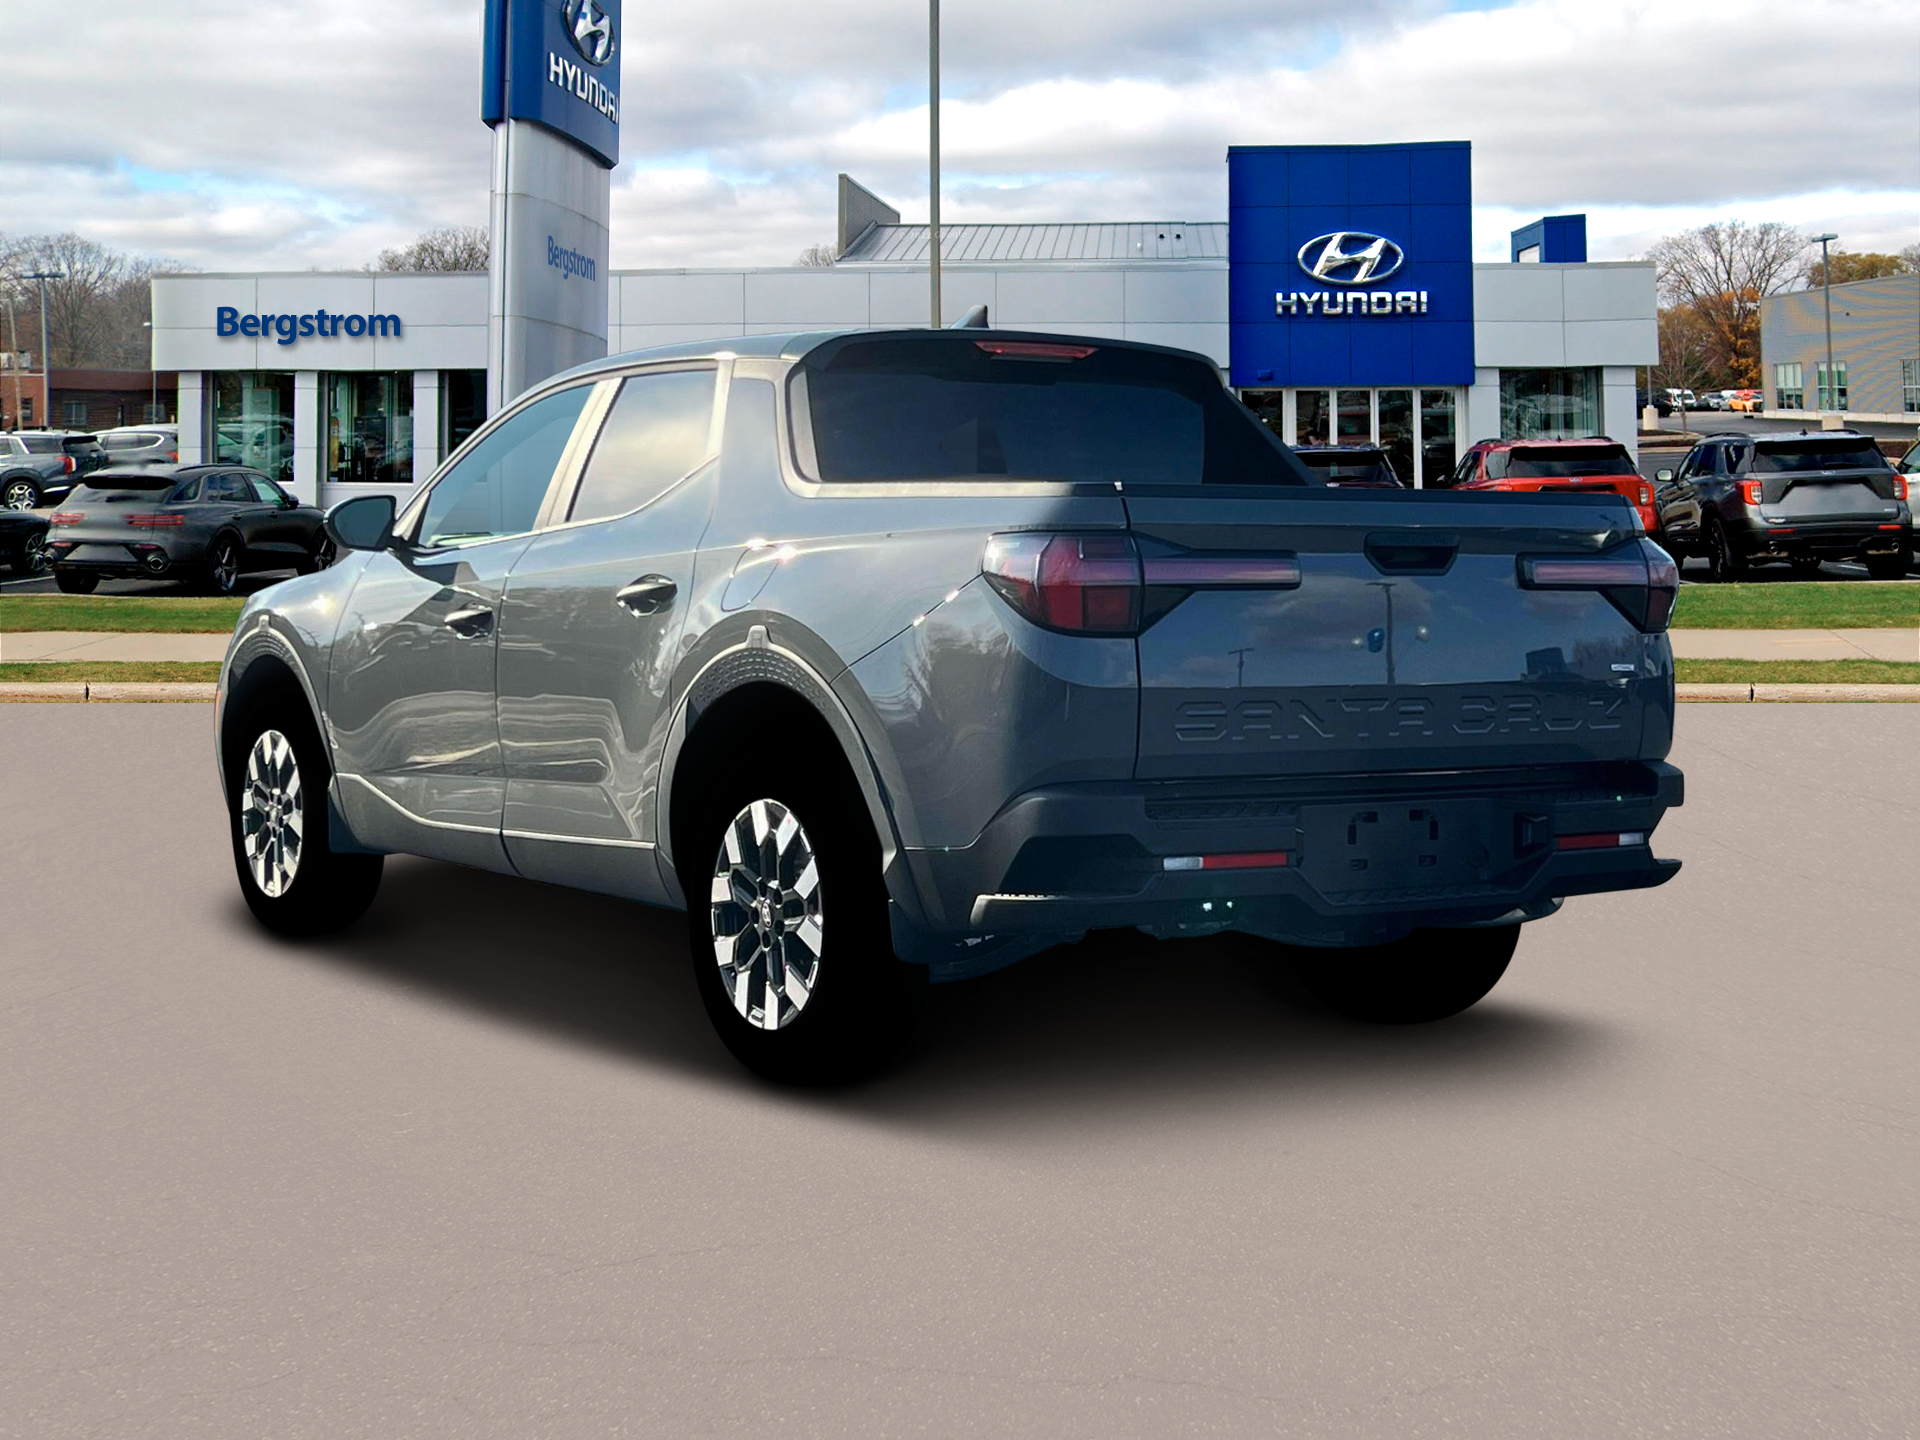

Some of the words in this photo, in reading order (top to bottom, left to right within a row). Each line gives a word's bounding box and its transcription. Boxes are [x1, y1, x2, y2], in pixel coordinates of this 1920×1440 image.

[549, 52, 619, 124] HYUNDAI
[548, 235, 596, 282] Bergstrom
[217, 306, 402, 345] Bergstrom
[1275, 291, 1428, 316] HYUNDAI
[1174, 695, 1435, 743] SANTA
[1452, 693, 1625, 736] CRUZ
